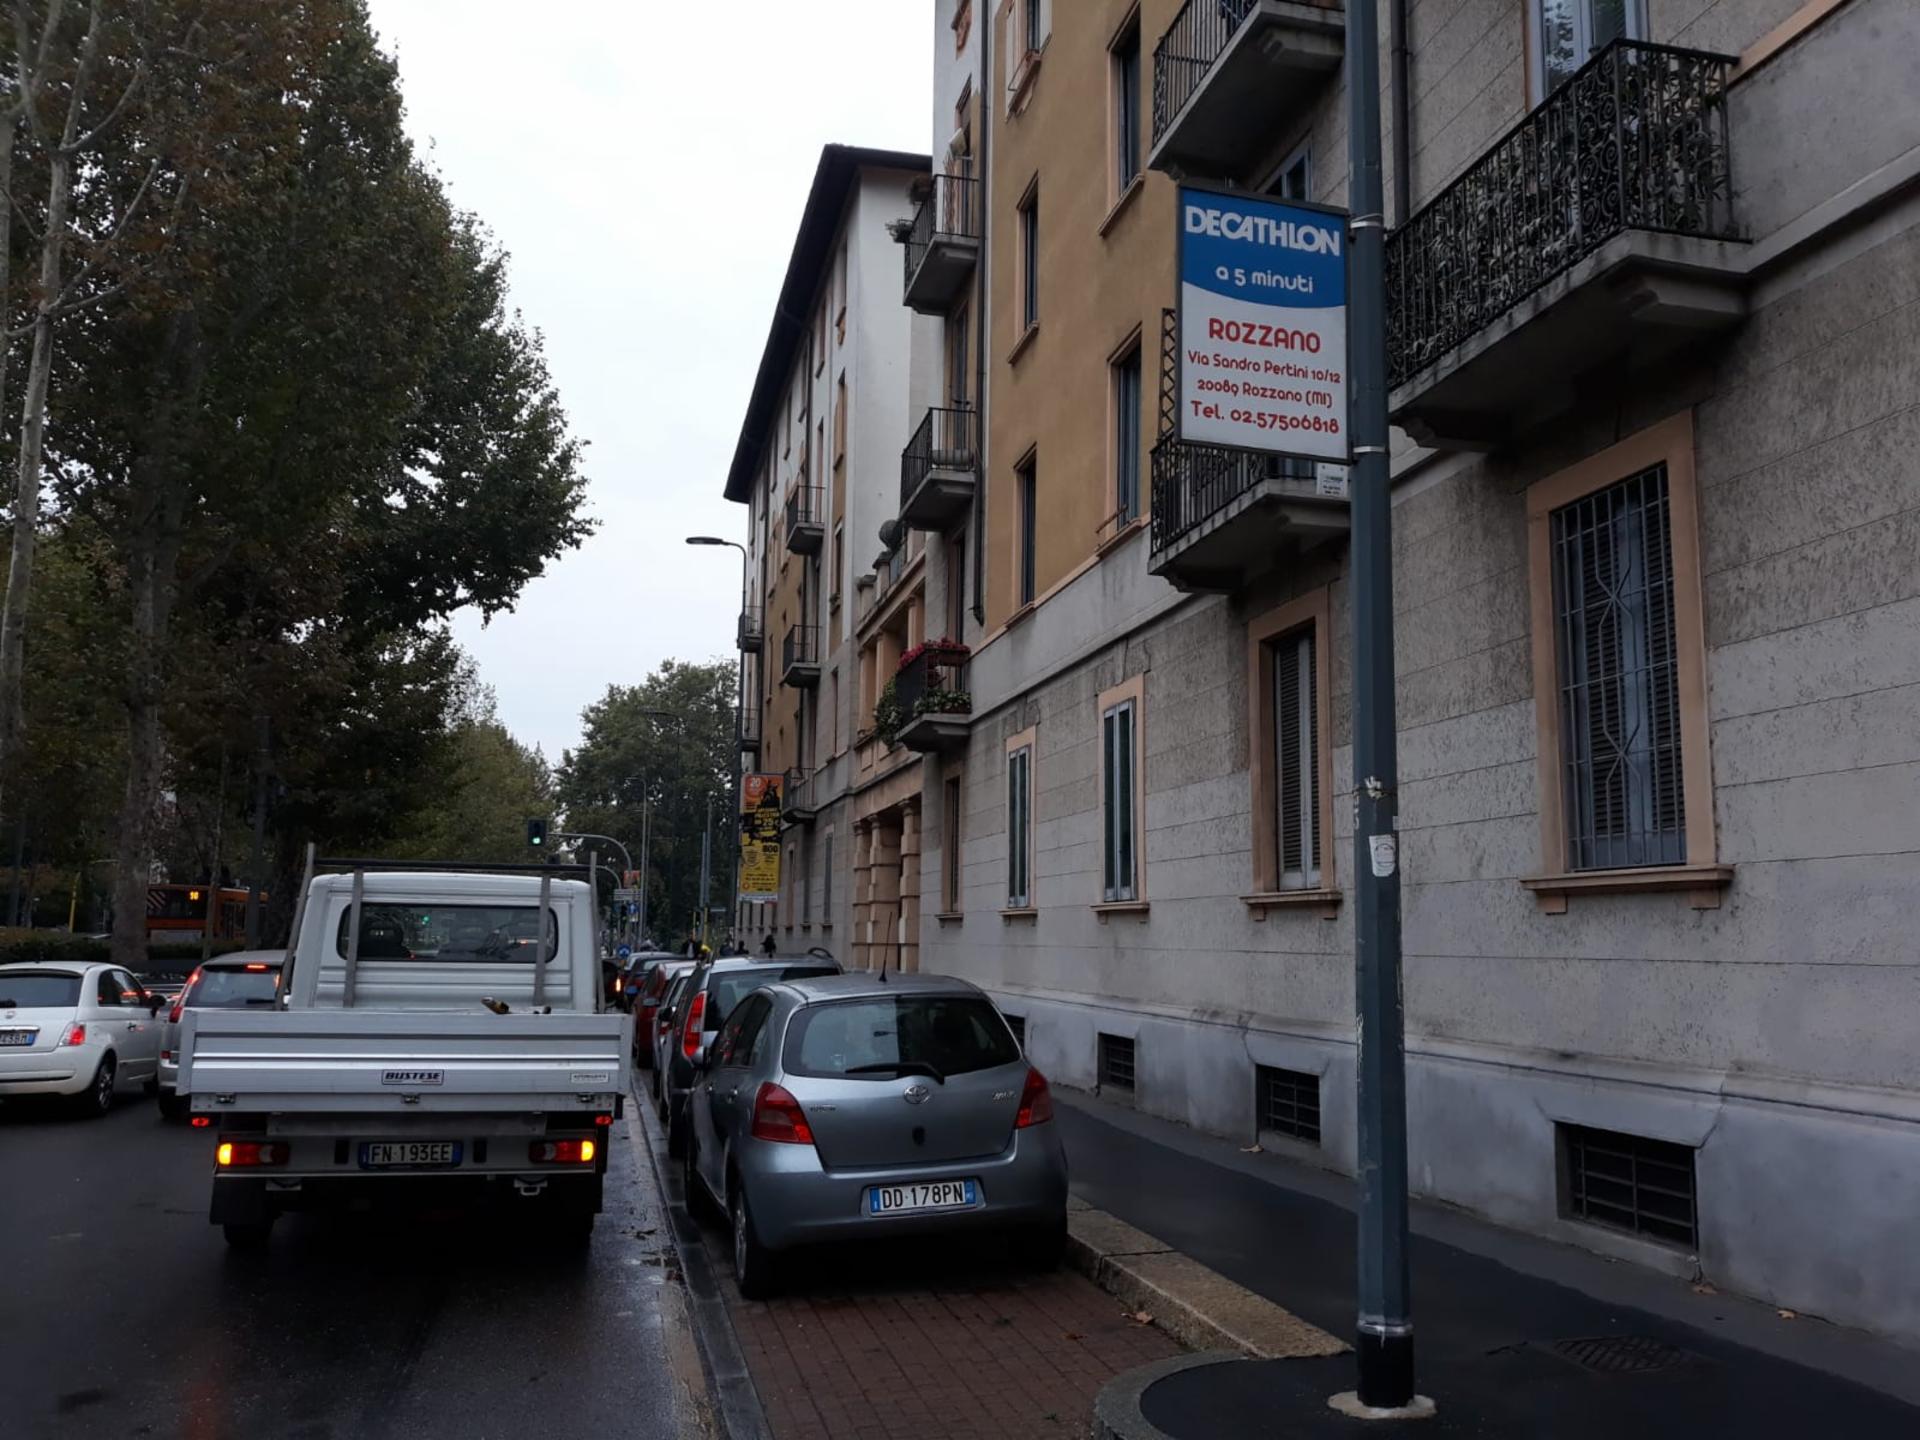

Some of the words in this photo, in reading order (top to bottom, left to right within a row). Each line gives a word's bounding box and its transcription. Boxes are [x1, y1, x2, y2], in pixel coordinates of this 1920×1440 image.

[1185, 205, 1340, 257] DECATHLON
[1215, 266, 1229, 280] a
[1234, 268, 1247, 286] 5
[1251, 269, 1314, 294] minuti
[1208, 317, 1321, 353] ROZZANO
[1187, 350, 1210, 366] Via
[1213, 353, 1261, 373] Sandro
[1264, 360, 1309, 380] Pertini
[1310, 369, 1341, 384] 10/12
[1197, 379, 1239, 397] 20089
[1242, 382, 1303, 402] Rozzano
[1305, 390, 1333, 409] (MI)
[1190, 400, 1225, 420] Tel.
[1230, 408, 1340, 434] 02.57506818
[385, 1072, 441, 1080] BUSTESE
